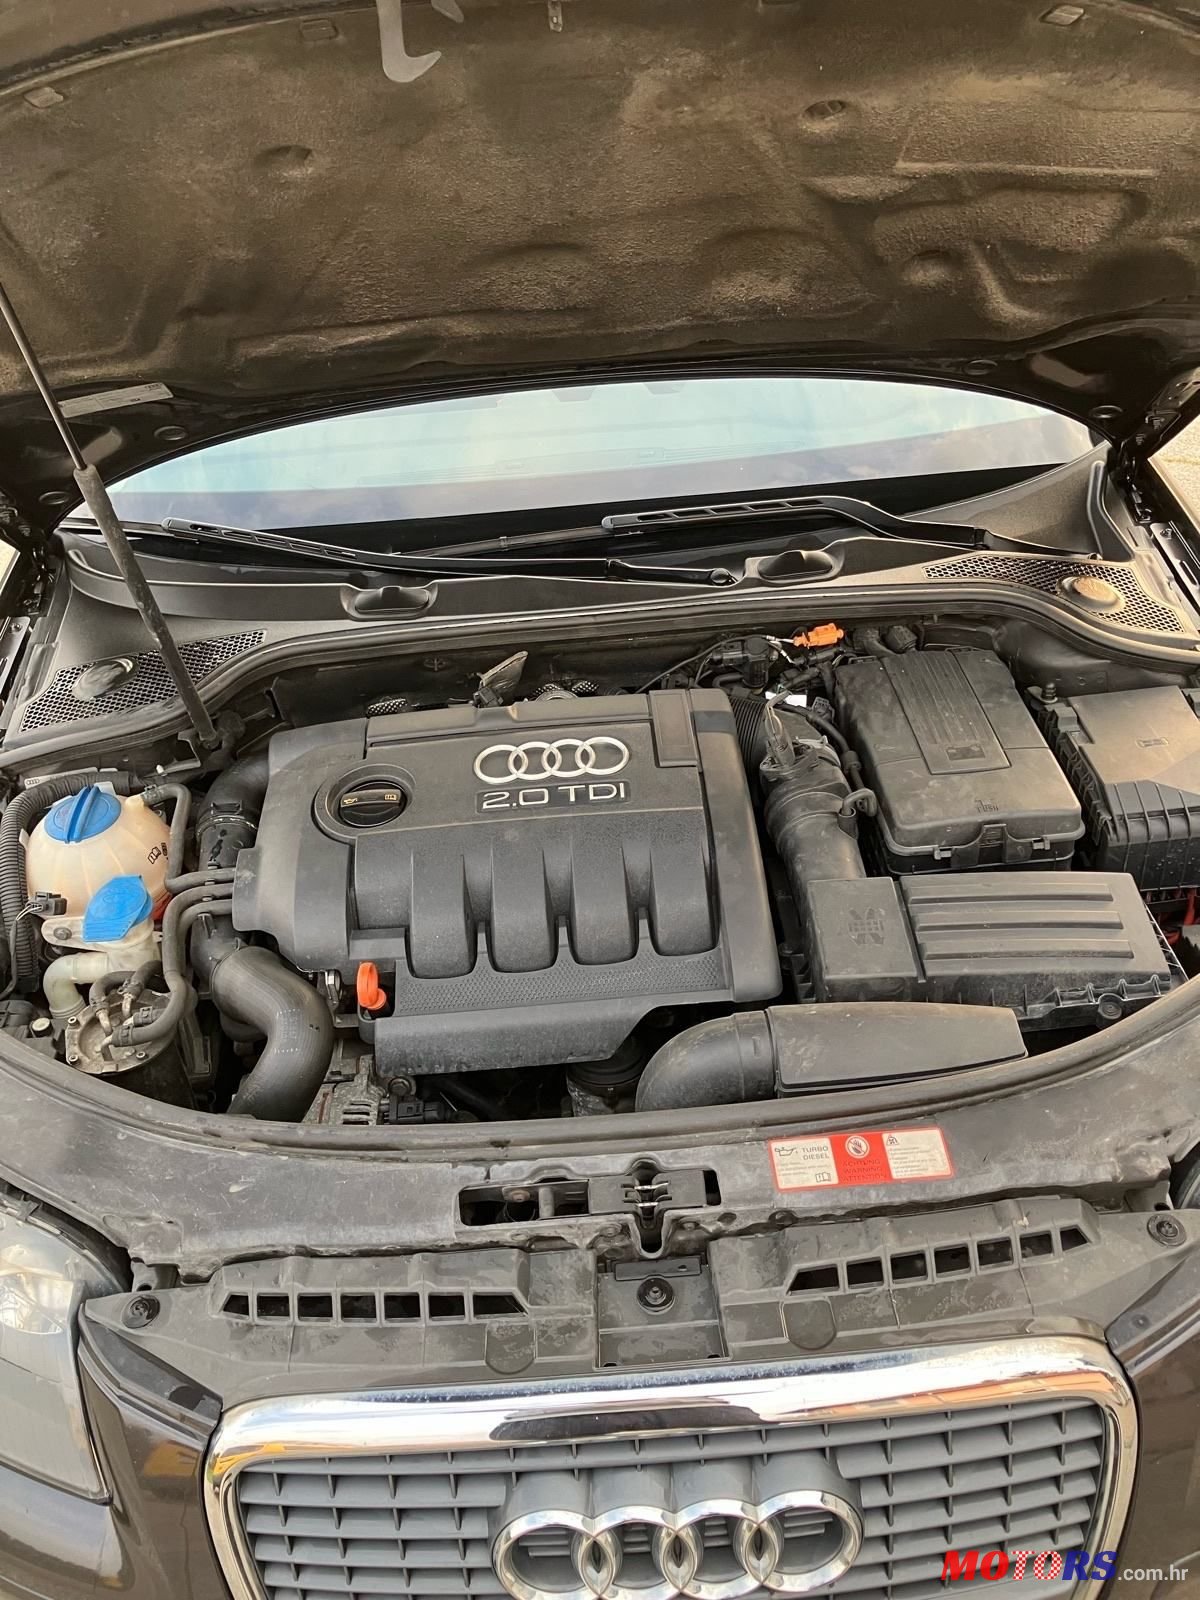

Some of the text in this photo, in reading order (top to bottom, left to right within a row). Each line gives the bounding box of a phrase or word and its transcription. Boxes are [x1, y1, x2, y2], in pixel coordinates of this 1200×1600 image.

[482, 782, 625, 809] 2.0 TDI
[842, 1159, 881, 1168] ACHTUNG
[844, 1166, 883, 1174] WARNING
[843, 1173, 887, 1181] ATTENTION
